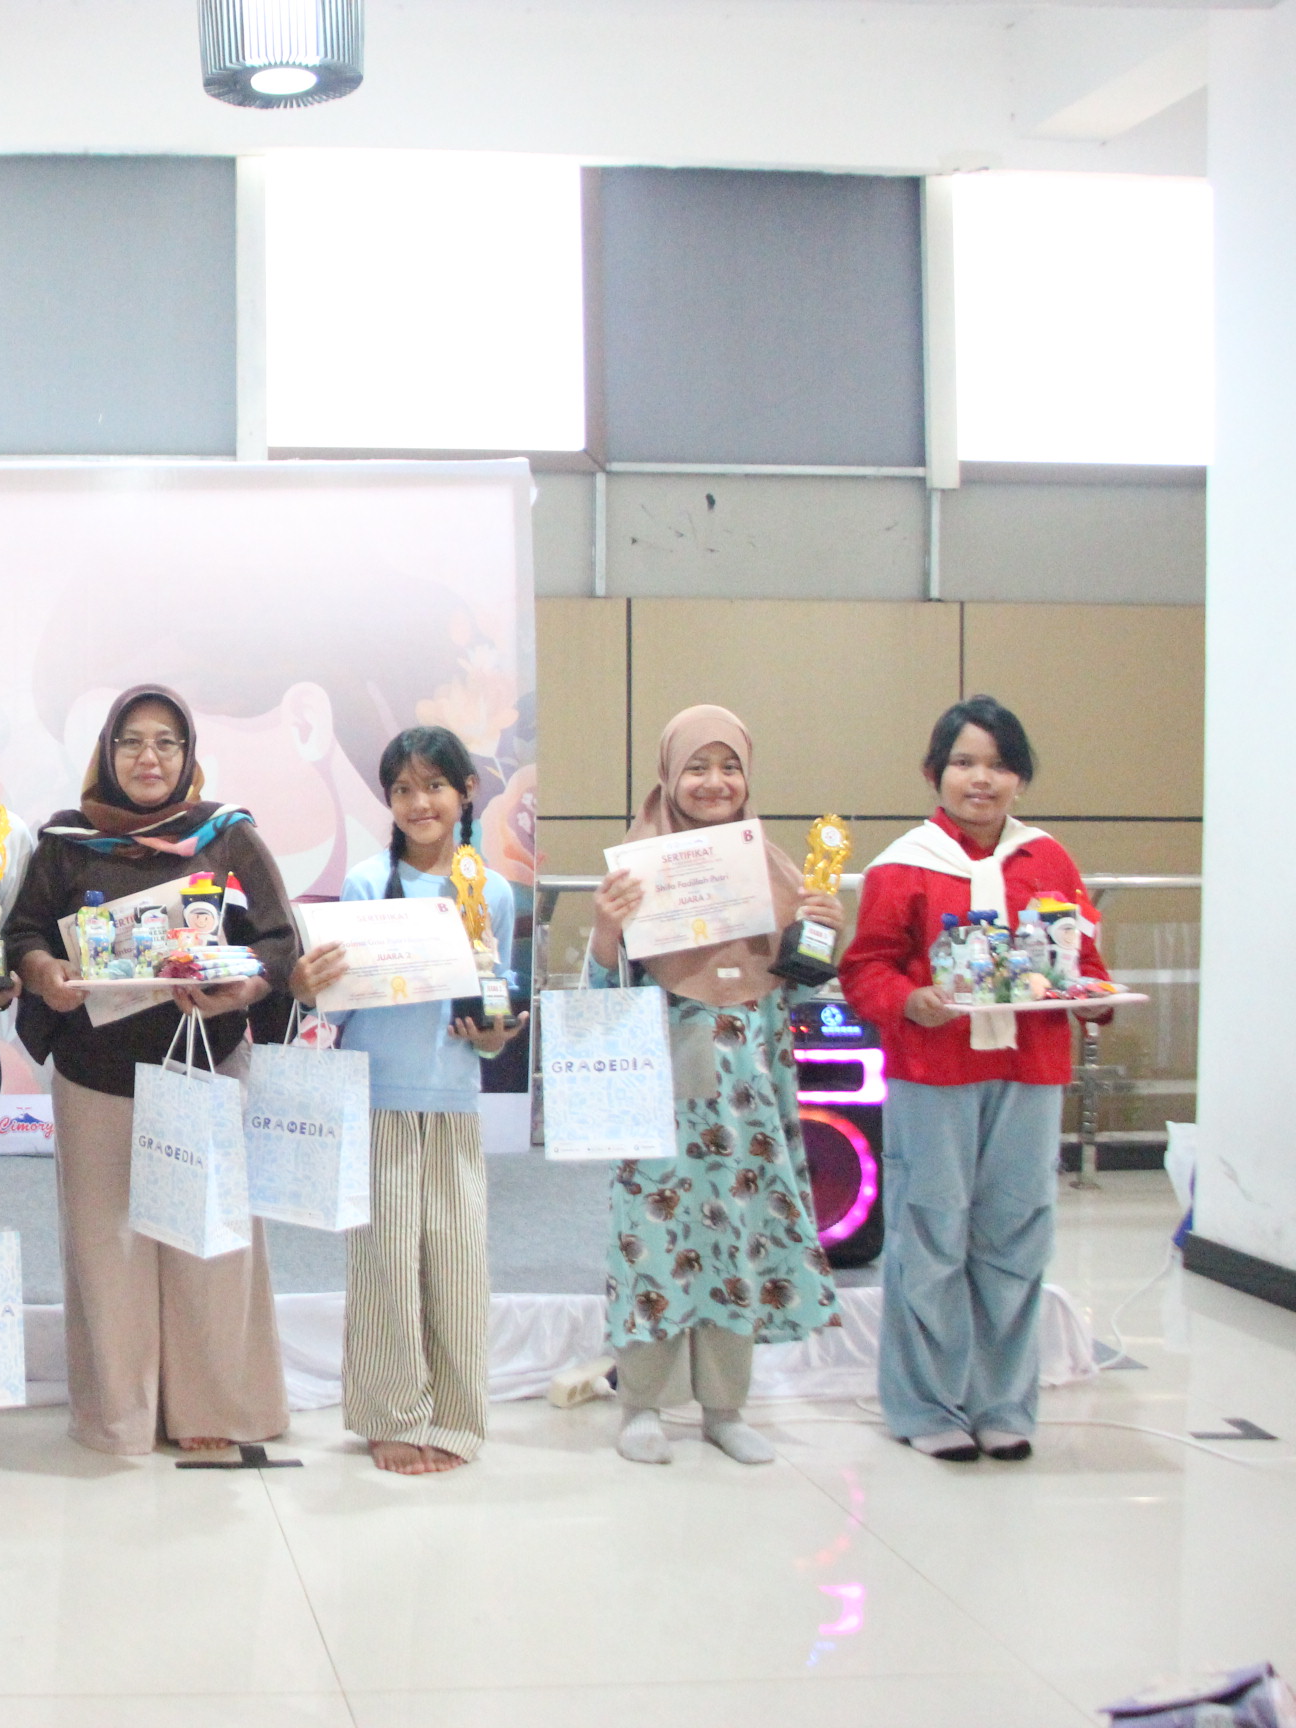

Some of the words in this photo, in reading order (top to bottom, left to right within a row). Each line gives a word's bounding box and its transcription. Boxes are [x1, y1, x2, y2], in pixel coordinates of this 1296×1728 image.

[742, 829, 754, 844] B
[661, 846, 714, 864] SERTIFIKAT
[678, 894, 705, 905] JUARA
[437, 903, 449, 914] B
[376, 952, 405, 962] JUARA
[551, 1056, 654, 1074] GRAMEDIA
[251, 1115, 336, 1138] GRAMEDIA
[138, 1134, 204, 1169] GRAMEDIA
